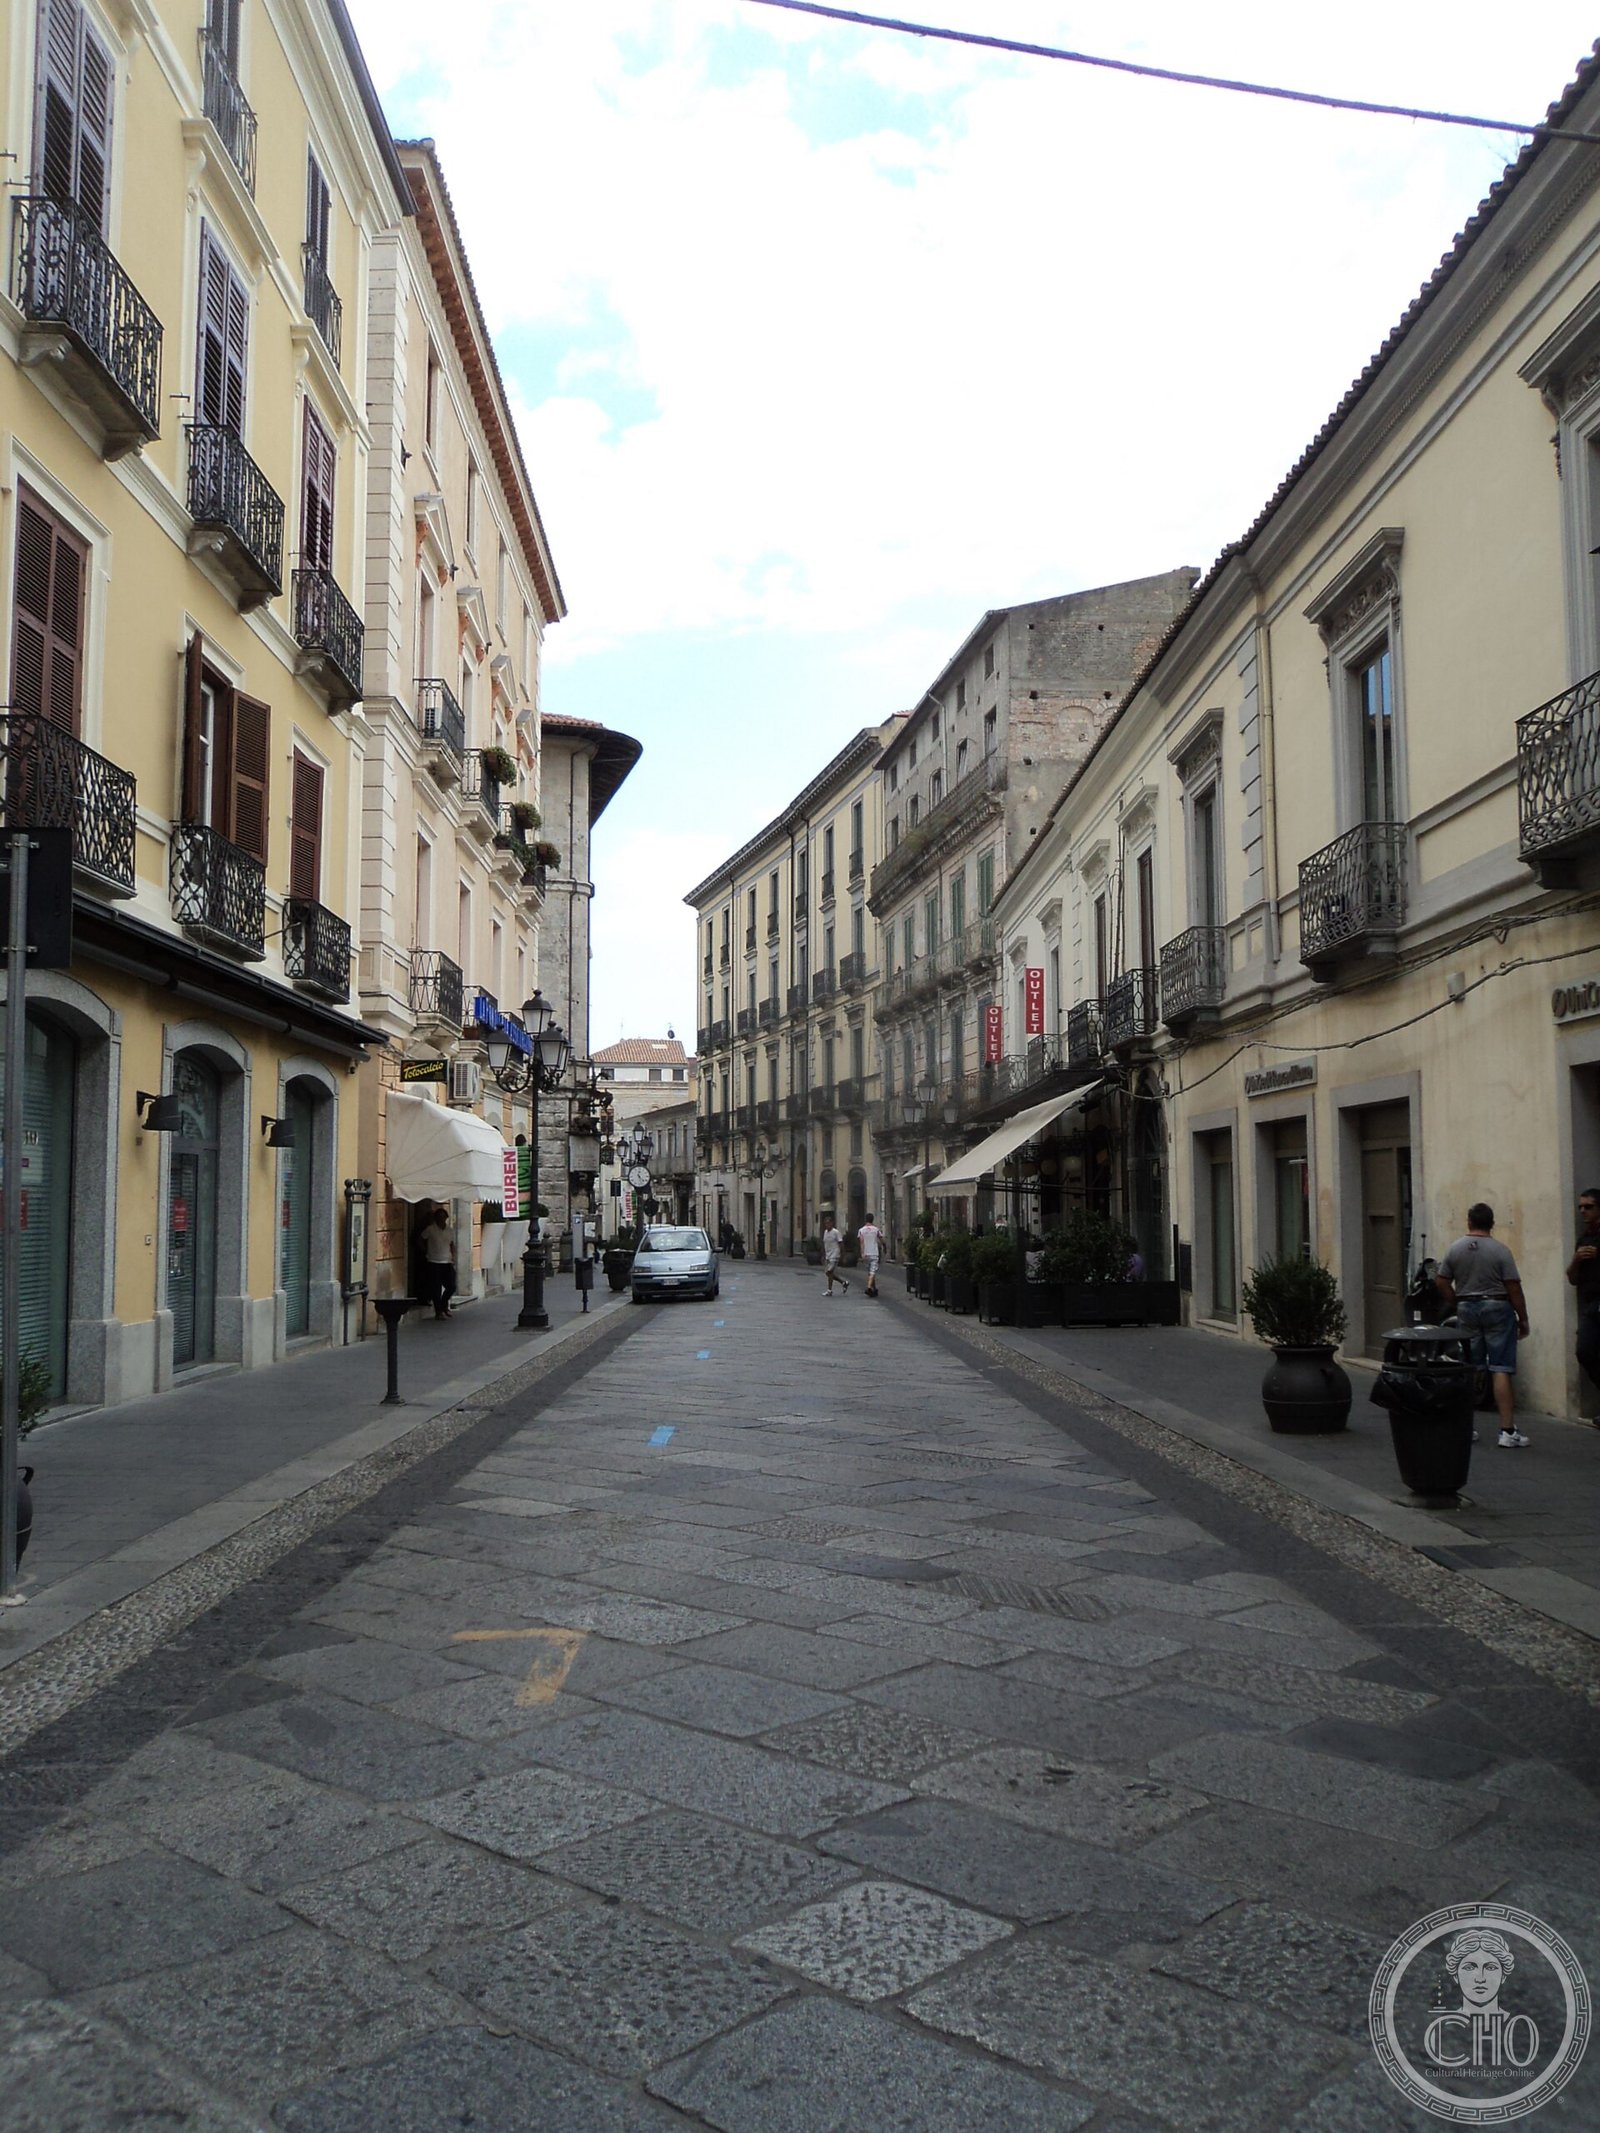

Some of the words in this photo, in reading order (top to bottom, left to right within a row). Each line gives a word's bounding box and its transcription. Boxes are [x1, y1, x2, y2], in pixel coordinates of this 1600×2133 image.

[1030, 970, 1040, 1031] OUTLET
[989, 1007, 998, 1059] OUTLET
[503, 1151, 518, 1212] BUREN
